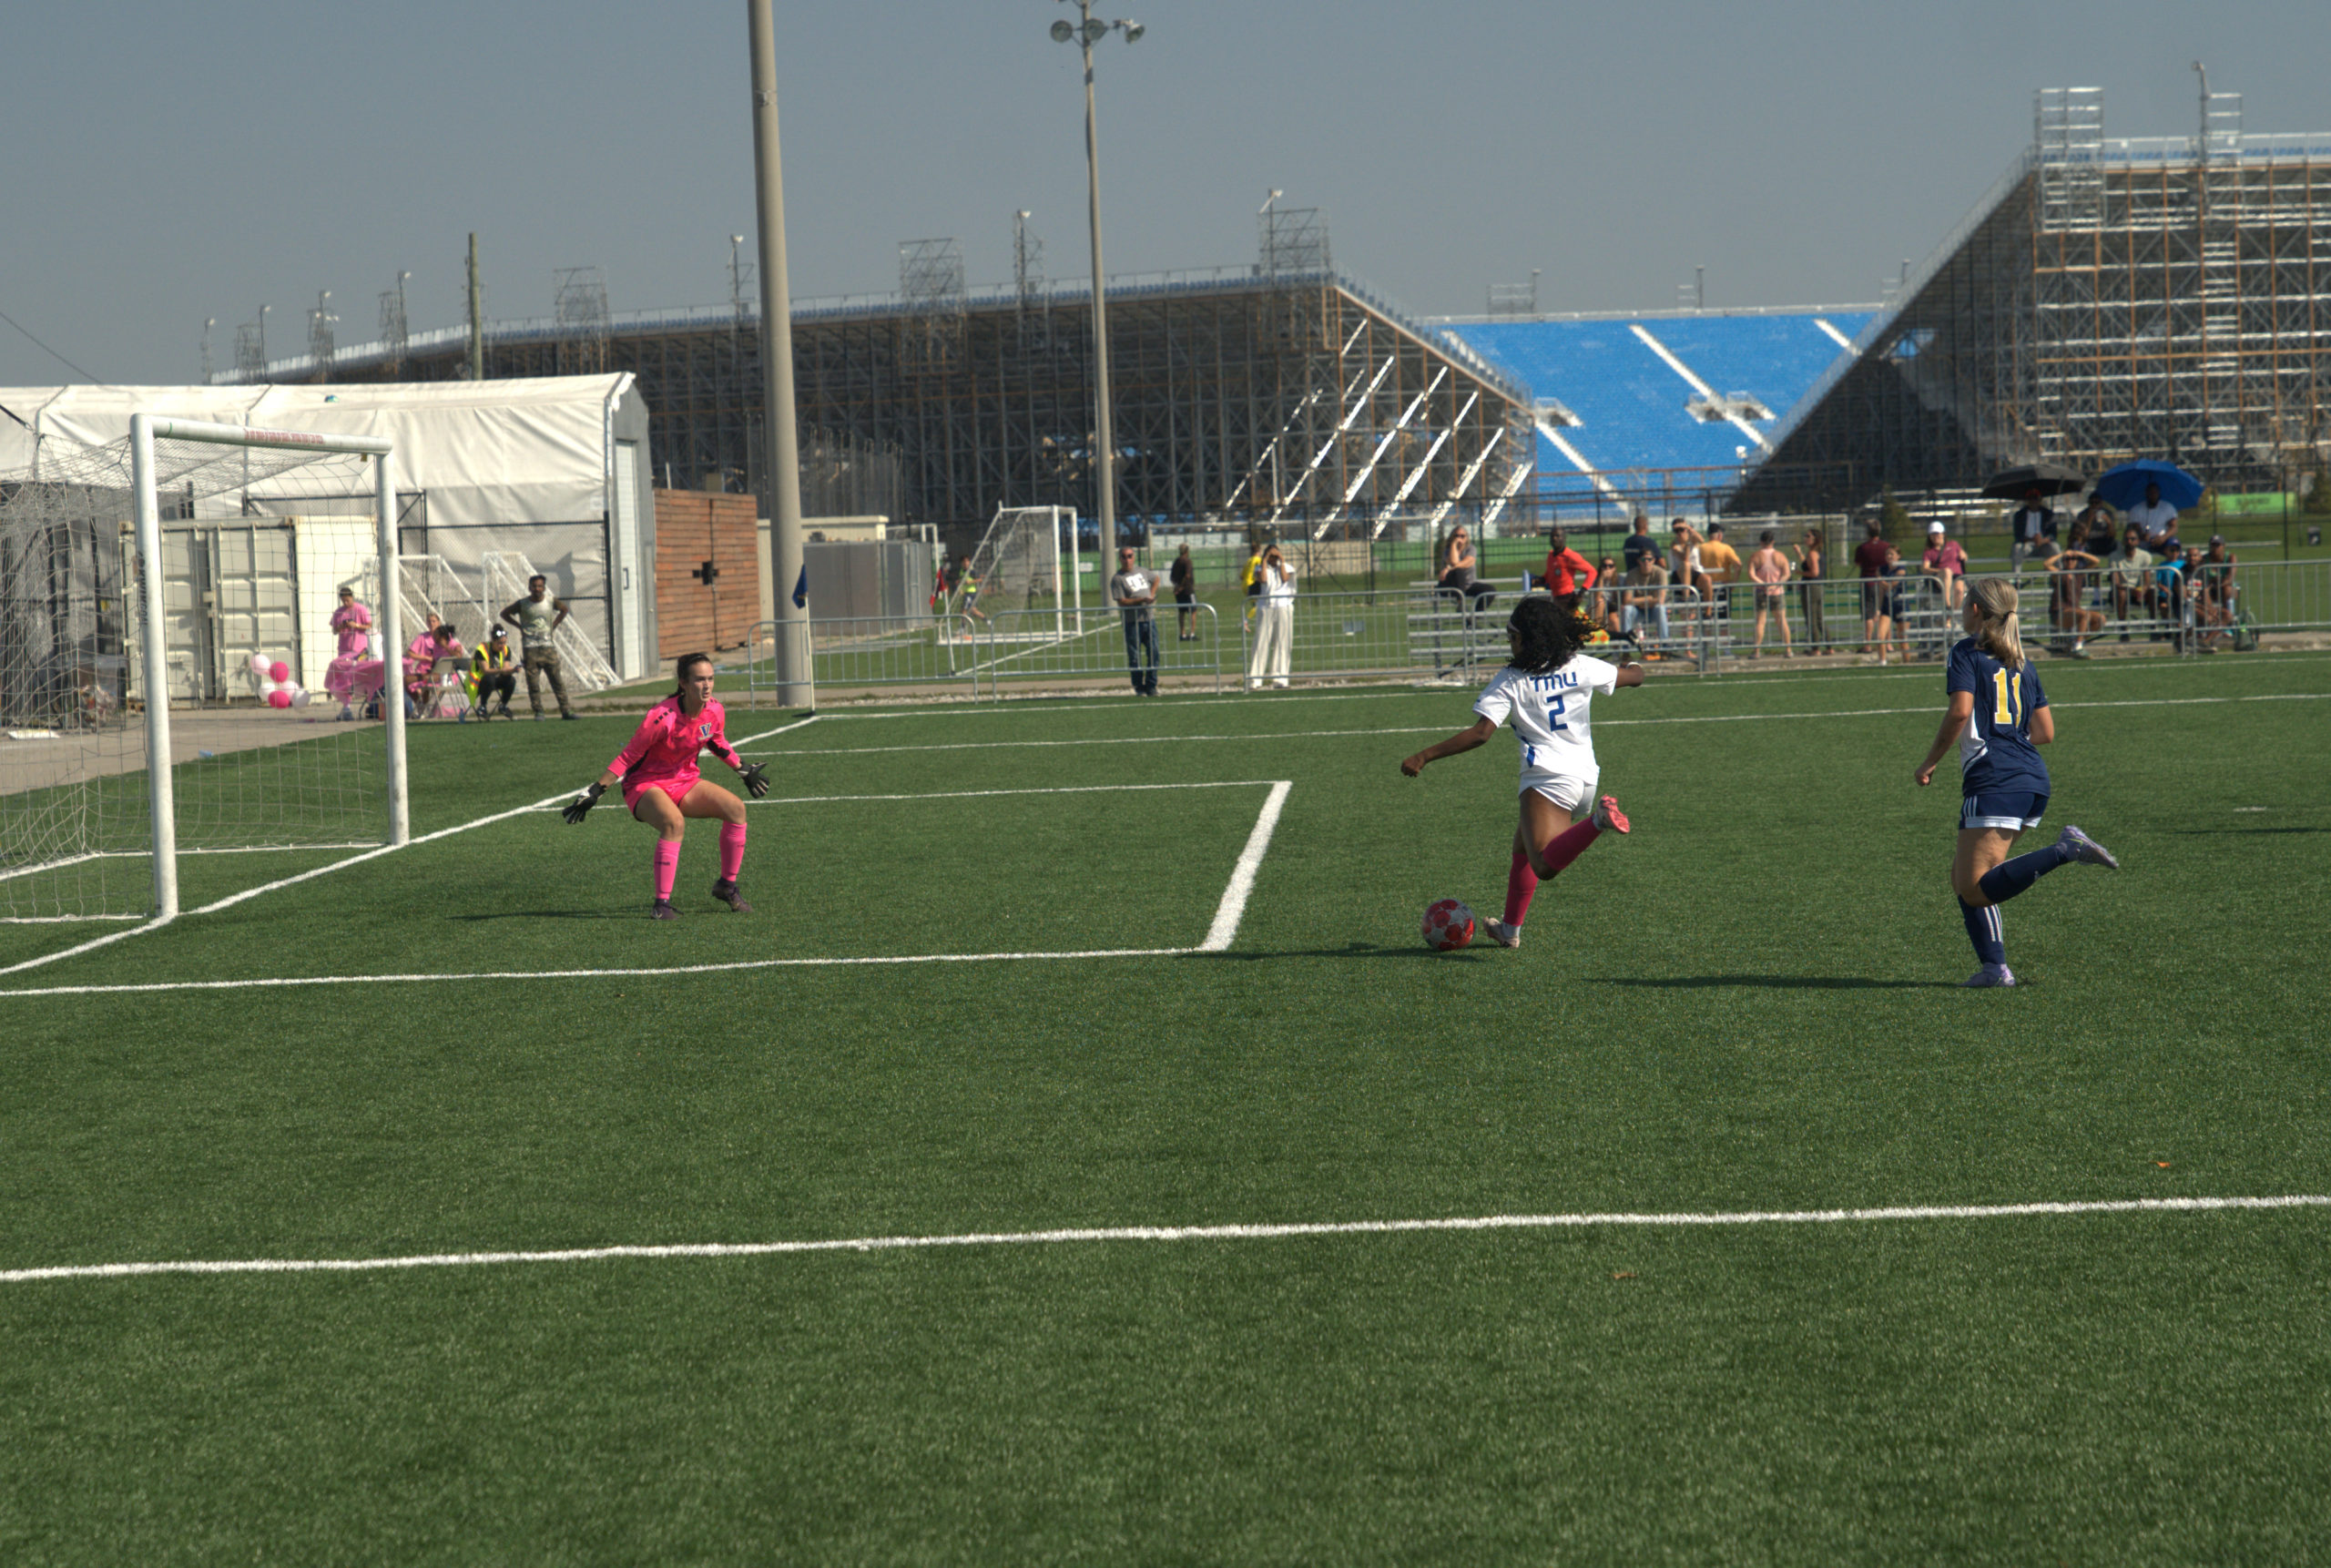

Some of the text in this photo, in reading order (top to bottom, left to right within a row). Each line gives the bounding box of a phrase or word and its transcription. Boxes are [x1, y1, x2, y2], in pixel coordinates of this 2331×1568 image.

[1530, 672, 1578, 692] TMU
[1993, 667, 2022, 728] 11
[1546, 695, 1568, 732] 2
